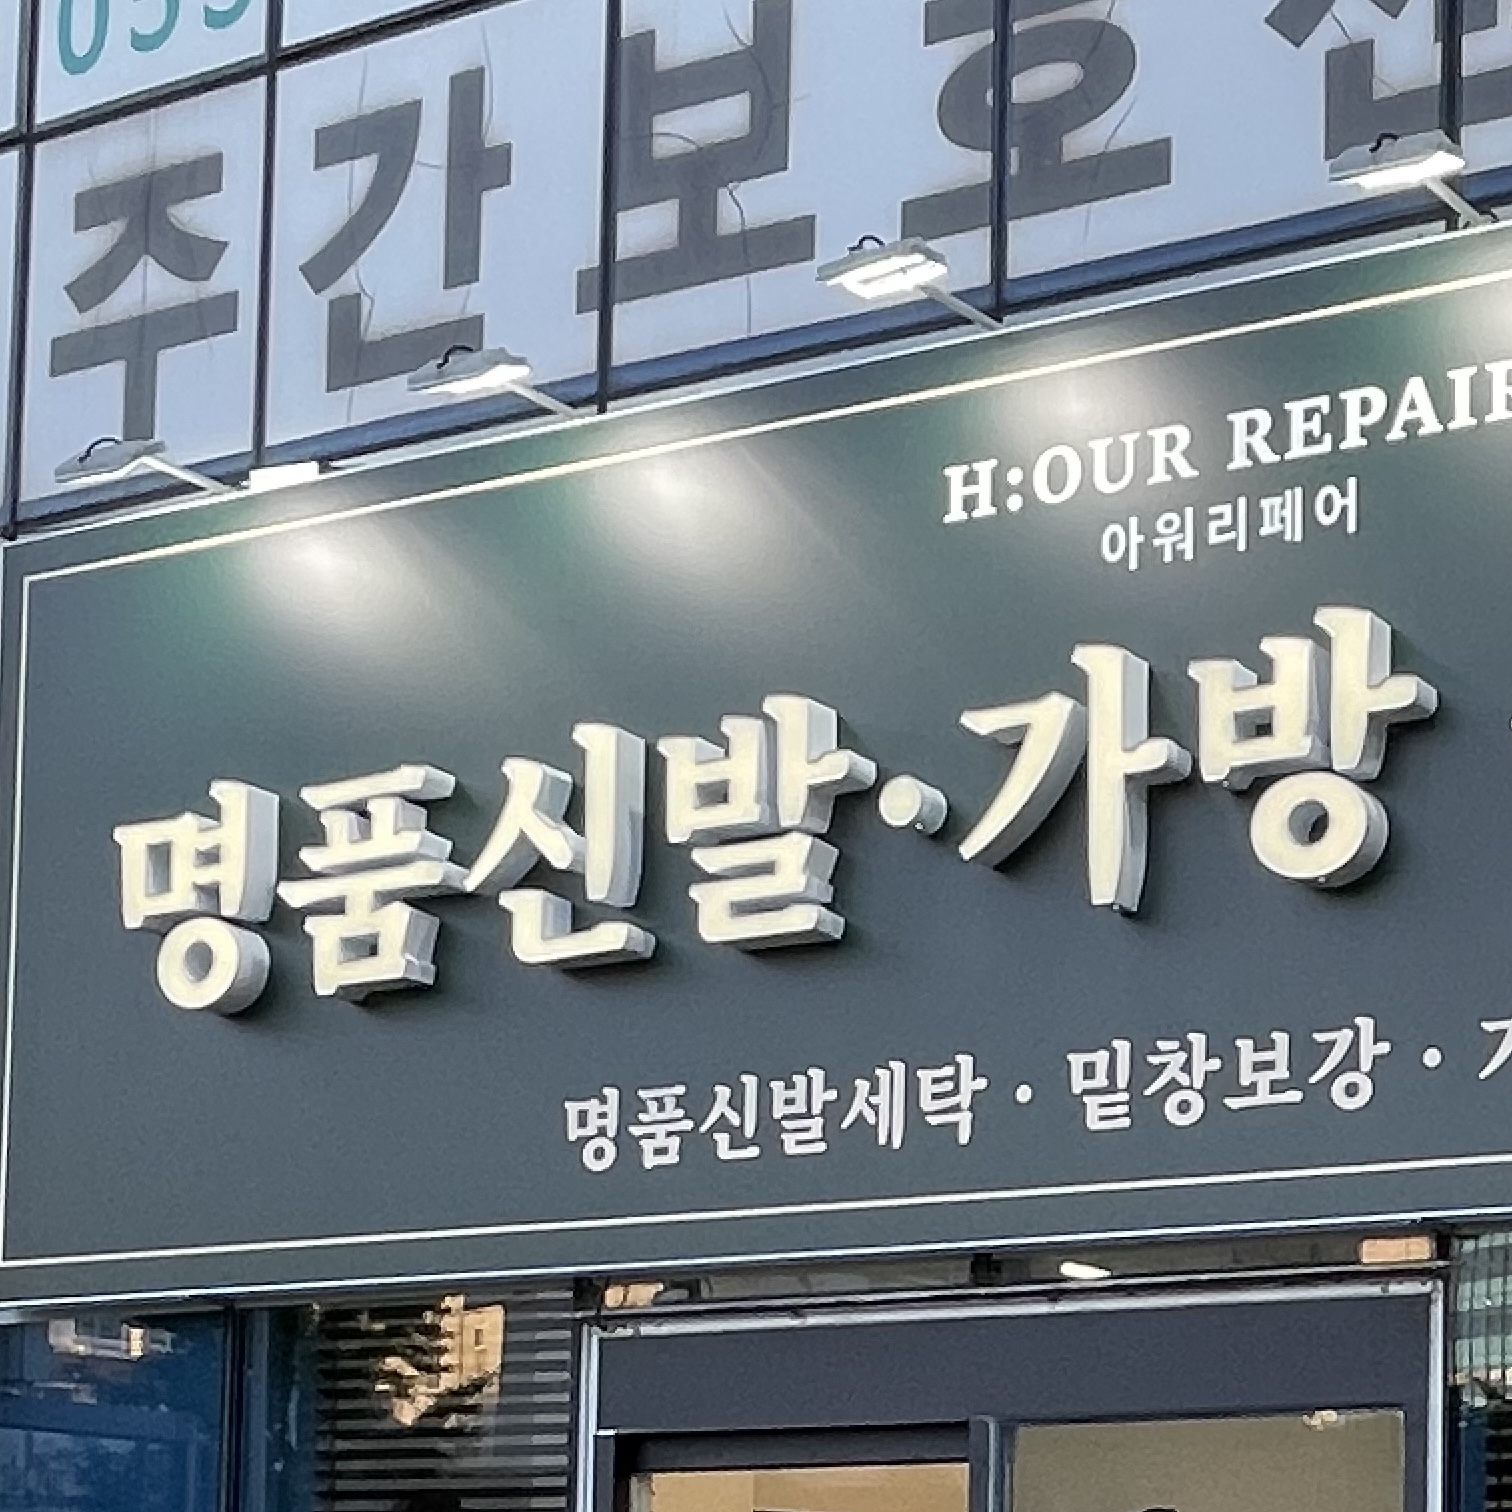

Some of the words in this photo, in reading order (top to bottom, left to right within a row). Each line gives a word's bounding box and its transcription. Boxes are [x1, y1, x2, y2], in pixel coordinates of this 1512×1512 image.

[942, 422, 1200, 525] H:OUR
[1101, 476, 1360, 572] 아워리페어
[564, 1054, 989, 1173] 명품신발세탁
[1066, 1014, 1392, 1131] 밑창보강
